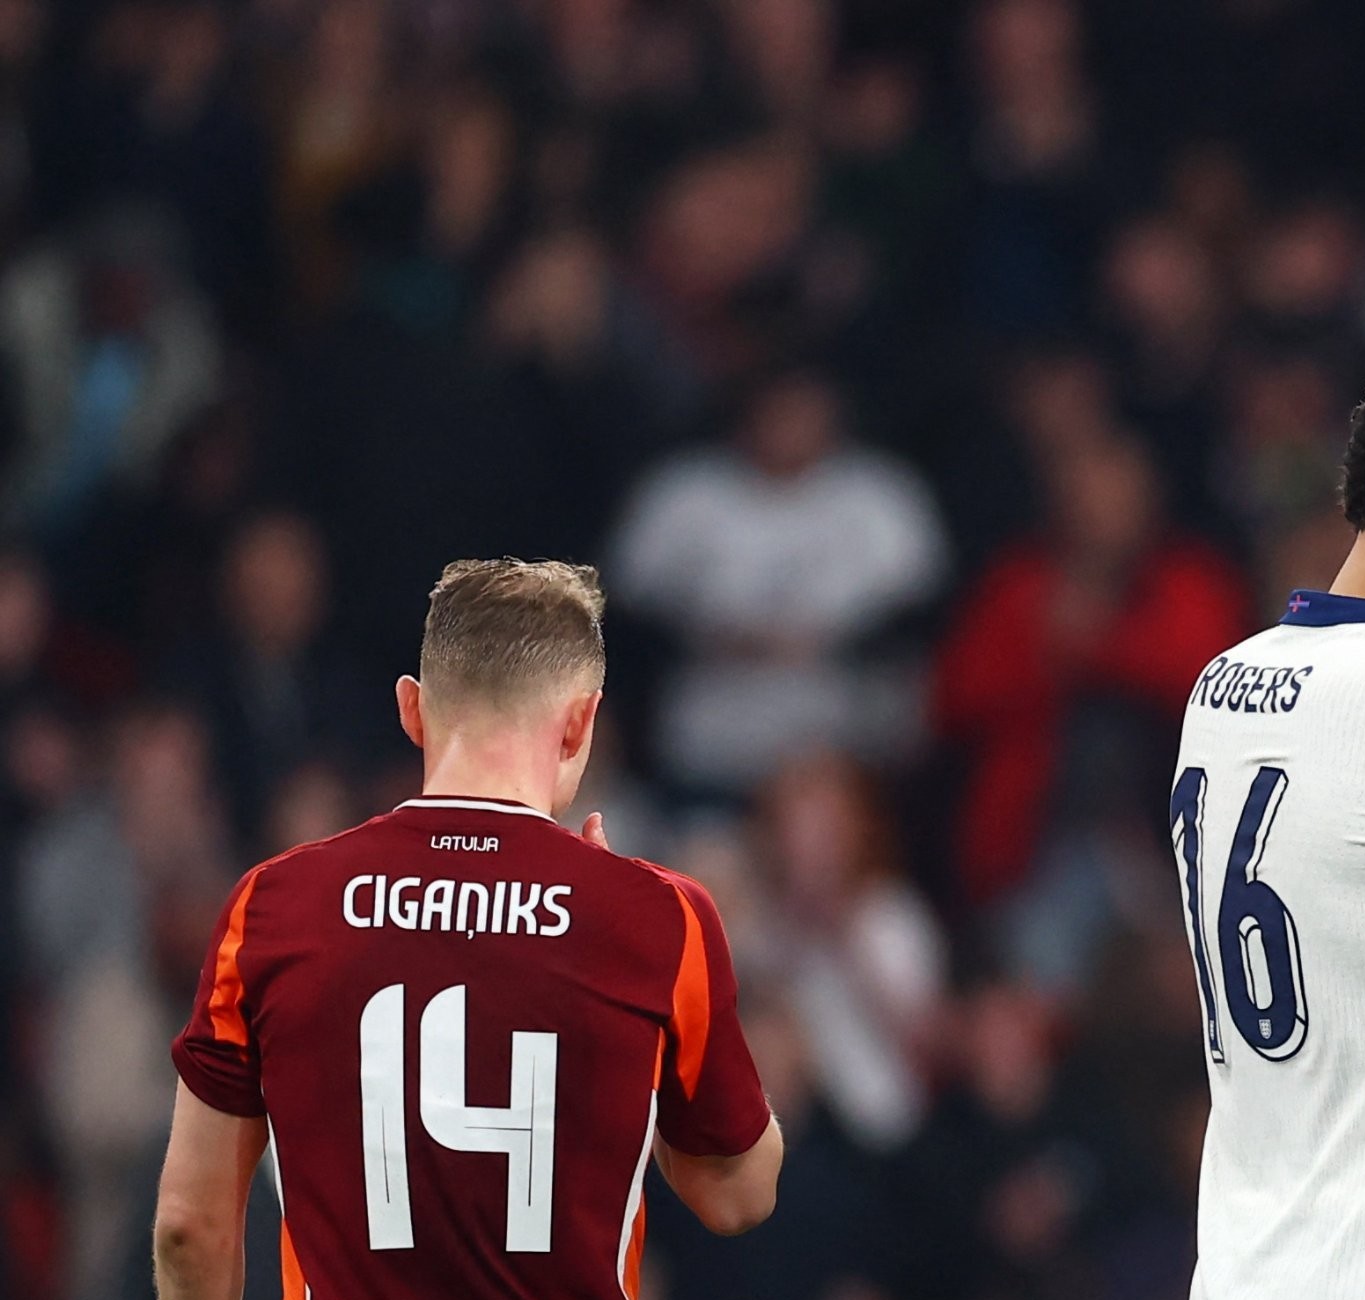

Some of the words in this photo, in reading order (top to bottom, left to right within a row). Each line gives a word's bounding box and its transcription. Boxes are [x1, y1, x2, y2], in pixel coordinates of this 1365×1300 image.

[1191, 656, 1313, 713] ROGERS
[342, 874, 572, 940] CIGAŅIKS
[1170, 766, 1309, 1063] 16
[360, 983, 558, 1252] 14
